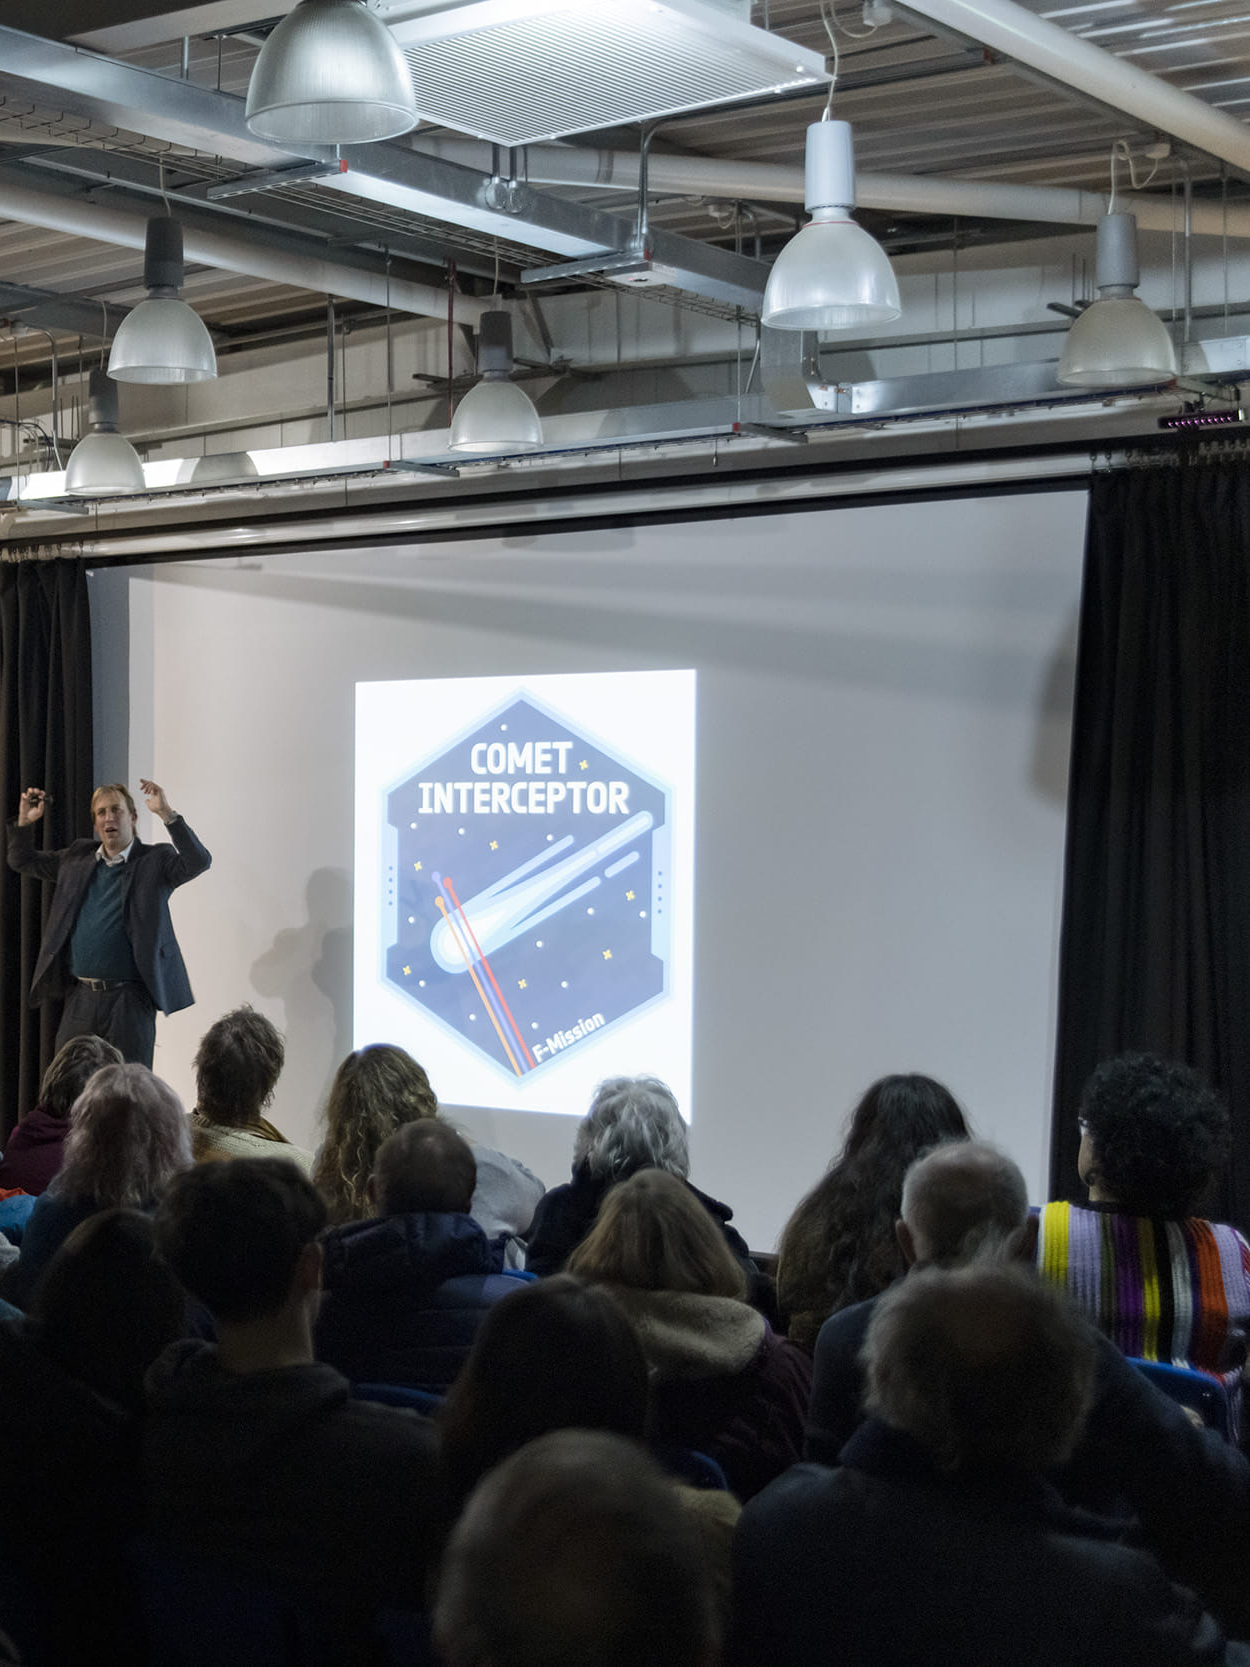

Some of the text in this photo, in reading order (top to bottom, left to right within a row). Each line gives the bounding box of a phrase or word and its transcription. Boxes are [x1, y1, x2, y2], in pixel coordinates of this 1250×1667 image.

[470, 741, 573, 774] COMET
[418, 781, 630, 814] INTERCEPTOR
[532, 1012, 605, 1063] F-Mission
